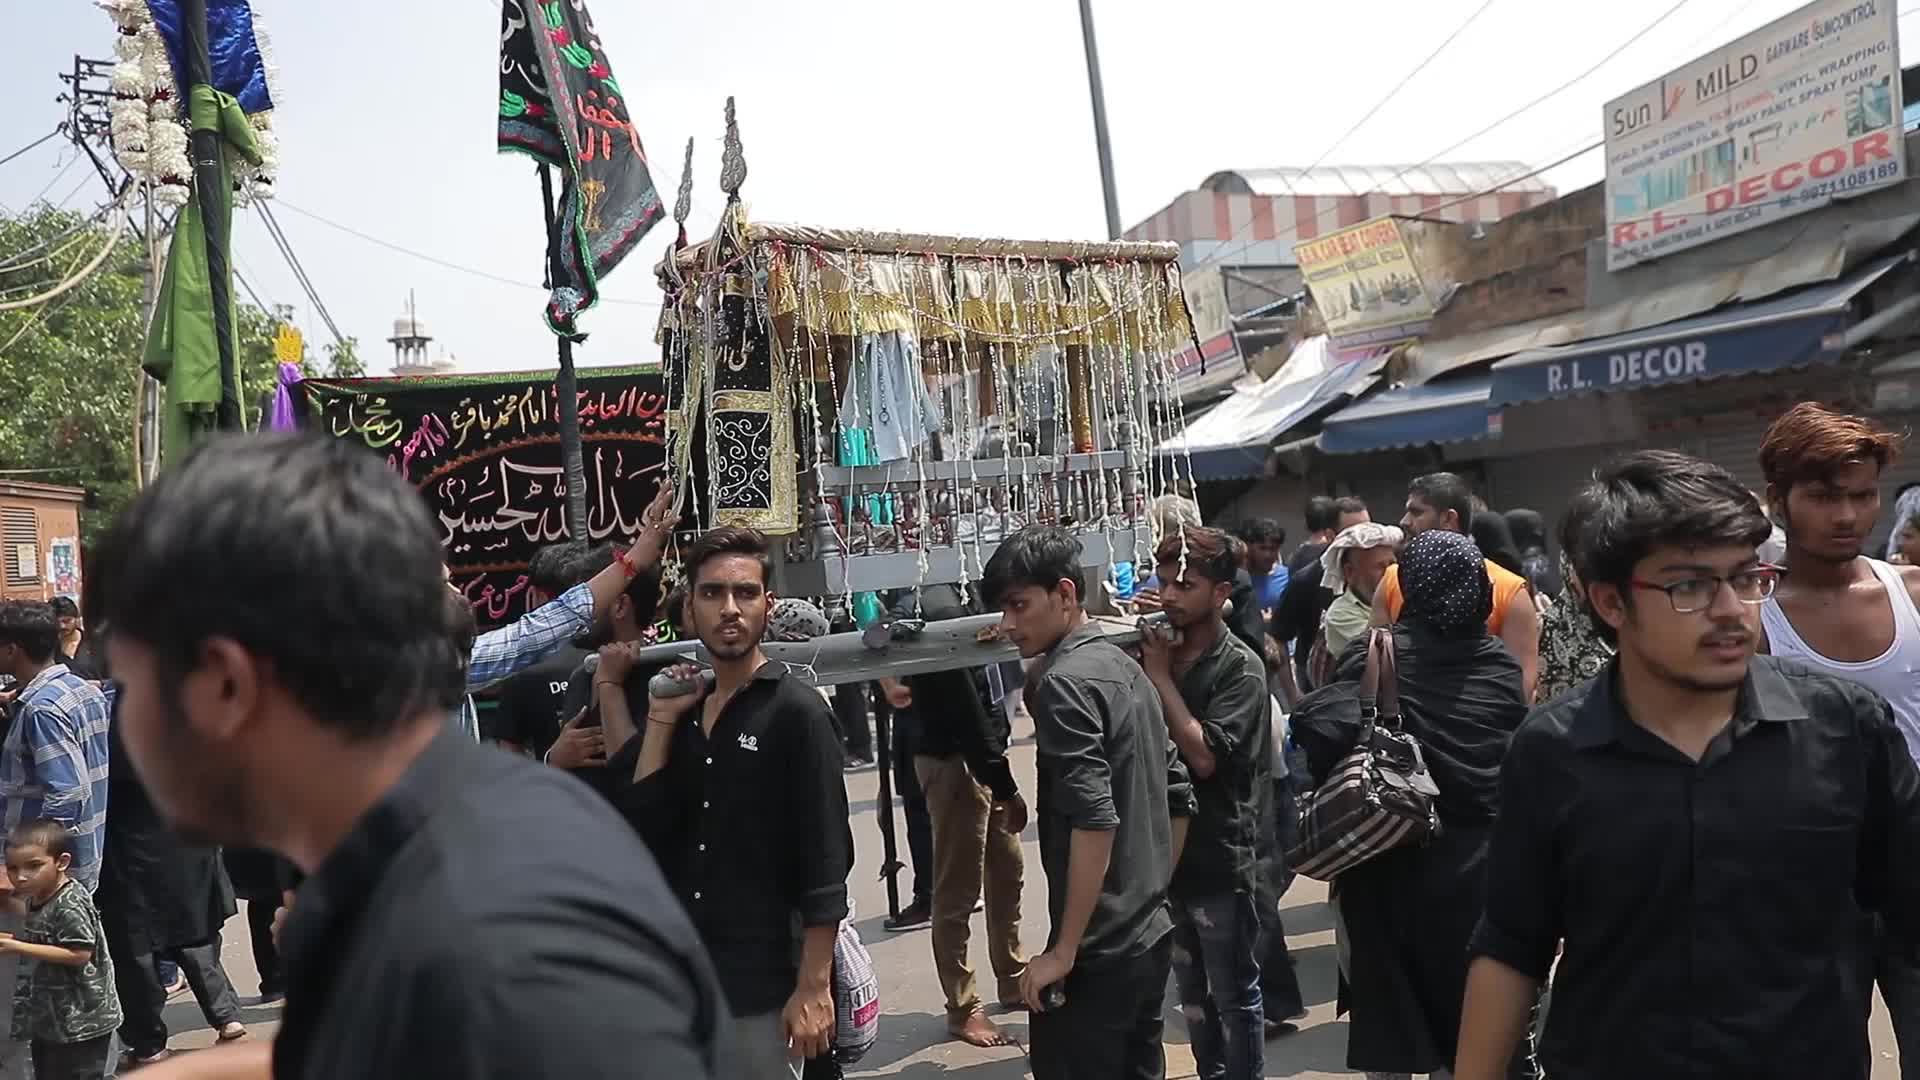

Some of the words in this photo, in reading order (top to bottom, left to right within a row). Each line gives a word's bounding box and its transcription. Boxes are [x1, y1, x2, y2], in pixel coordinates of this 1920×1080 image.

[1613, 102, 1651, 136] Sun
[1696, 54, 1758, 100] MILD
[1799, 80, 1837, 104] SPRAY
[1841, 64, 1878, 87] PUMP
[1612, 210, 1688, 249] R.L.
[1706, 130, 1893, 216] DECOR
[1548, 362, 1592, 392] R.L.
[1609, 342, 1706, 384] DECOR
